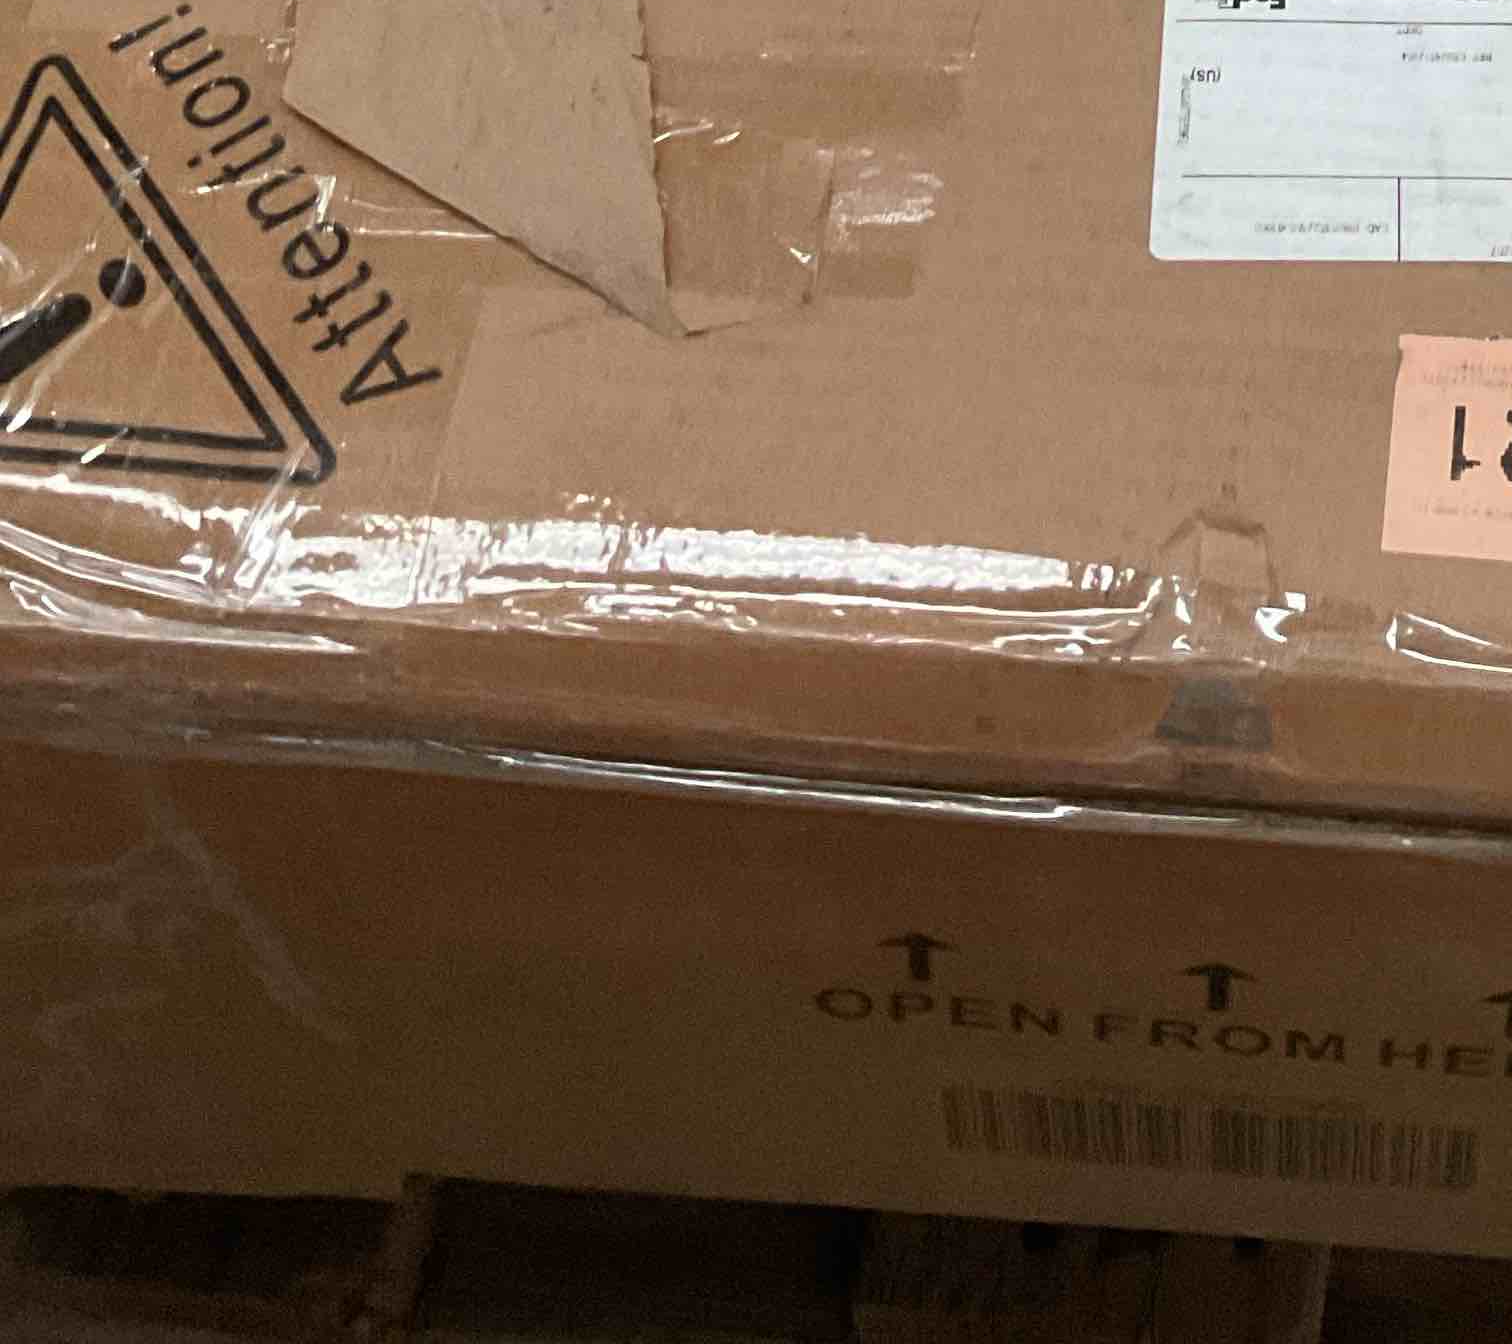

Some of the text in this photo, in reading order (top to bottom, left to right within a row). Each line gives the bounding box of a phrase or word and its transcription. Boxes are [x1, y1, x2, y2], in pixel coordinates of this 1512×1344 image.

[1190, 67, 1221, 83] (US)
[107, 3, 442, 405] Attention!
[814, 987, 1063, 1038] OPEN
[1092, 1013, 1347, 1066] FROM
